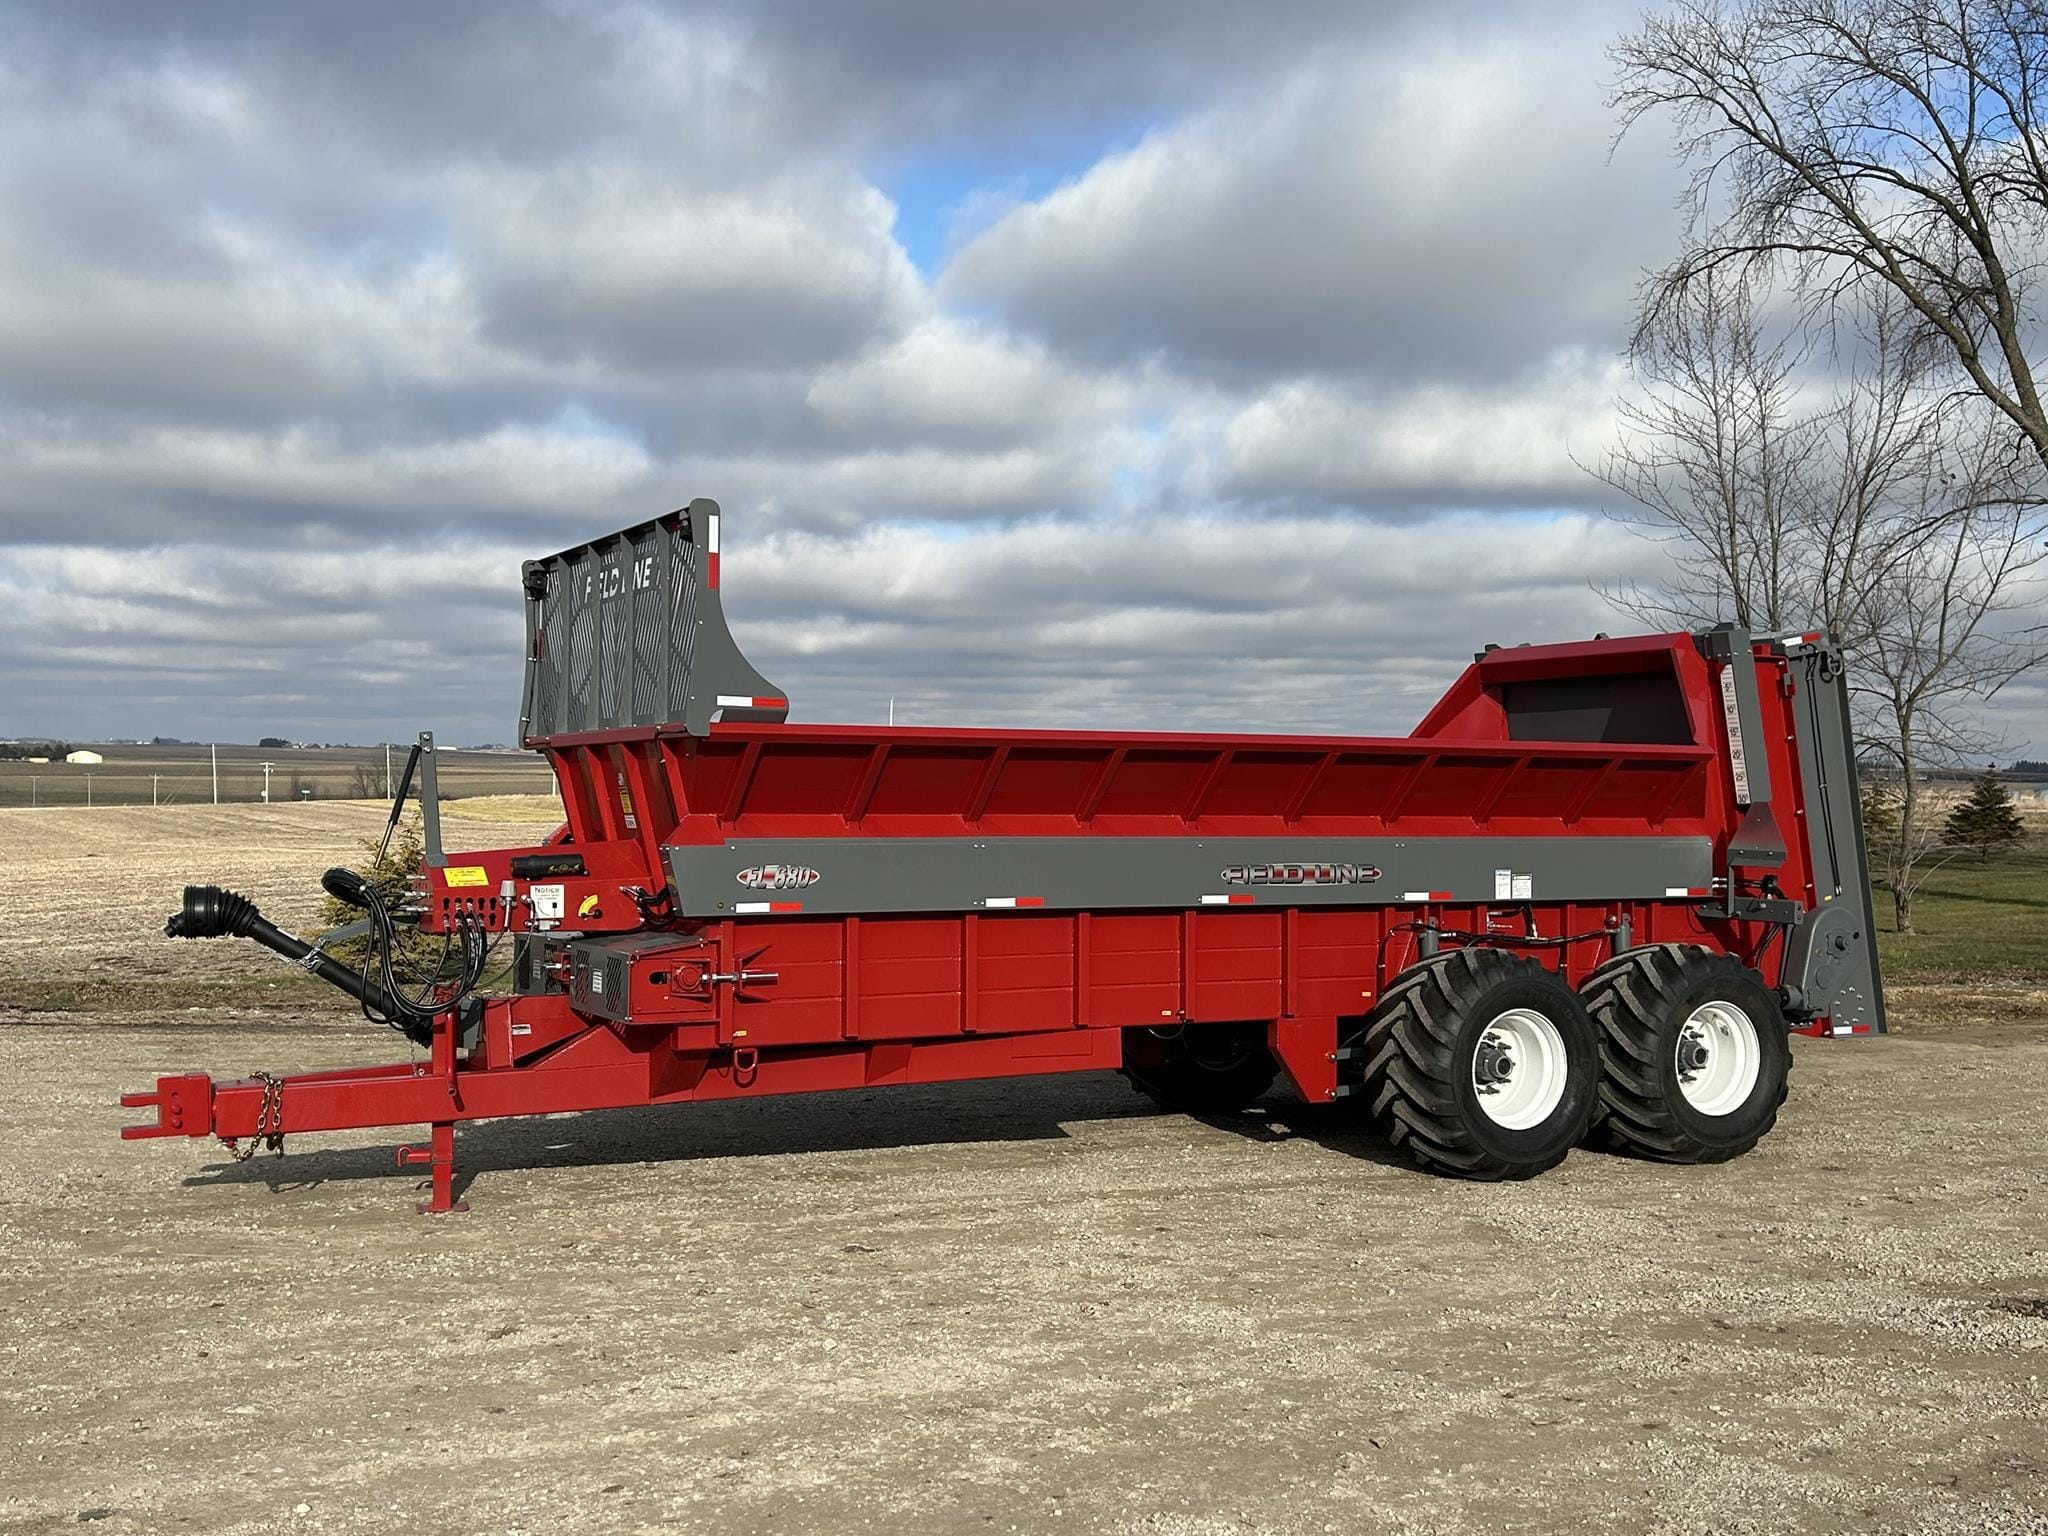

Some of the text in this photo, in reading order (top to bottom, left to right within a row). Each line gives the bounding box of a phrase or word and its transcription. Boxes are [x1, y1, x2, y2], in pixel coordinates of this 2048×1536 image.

[584, 557, 653, 604] FELD NE
[745, 864, 812, 889] FL 680
[1225, 863, 1376, 885] FIELD LINE
